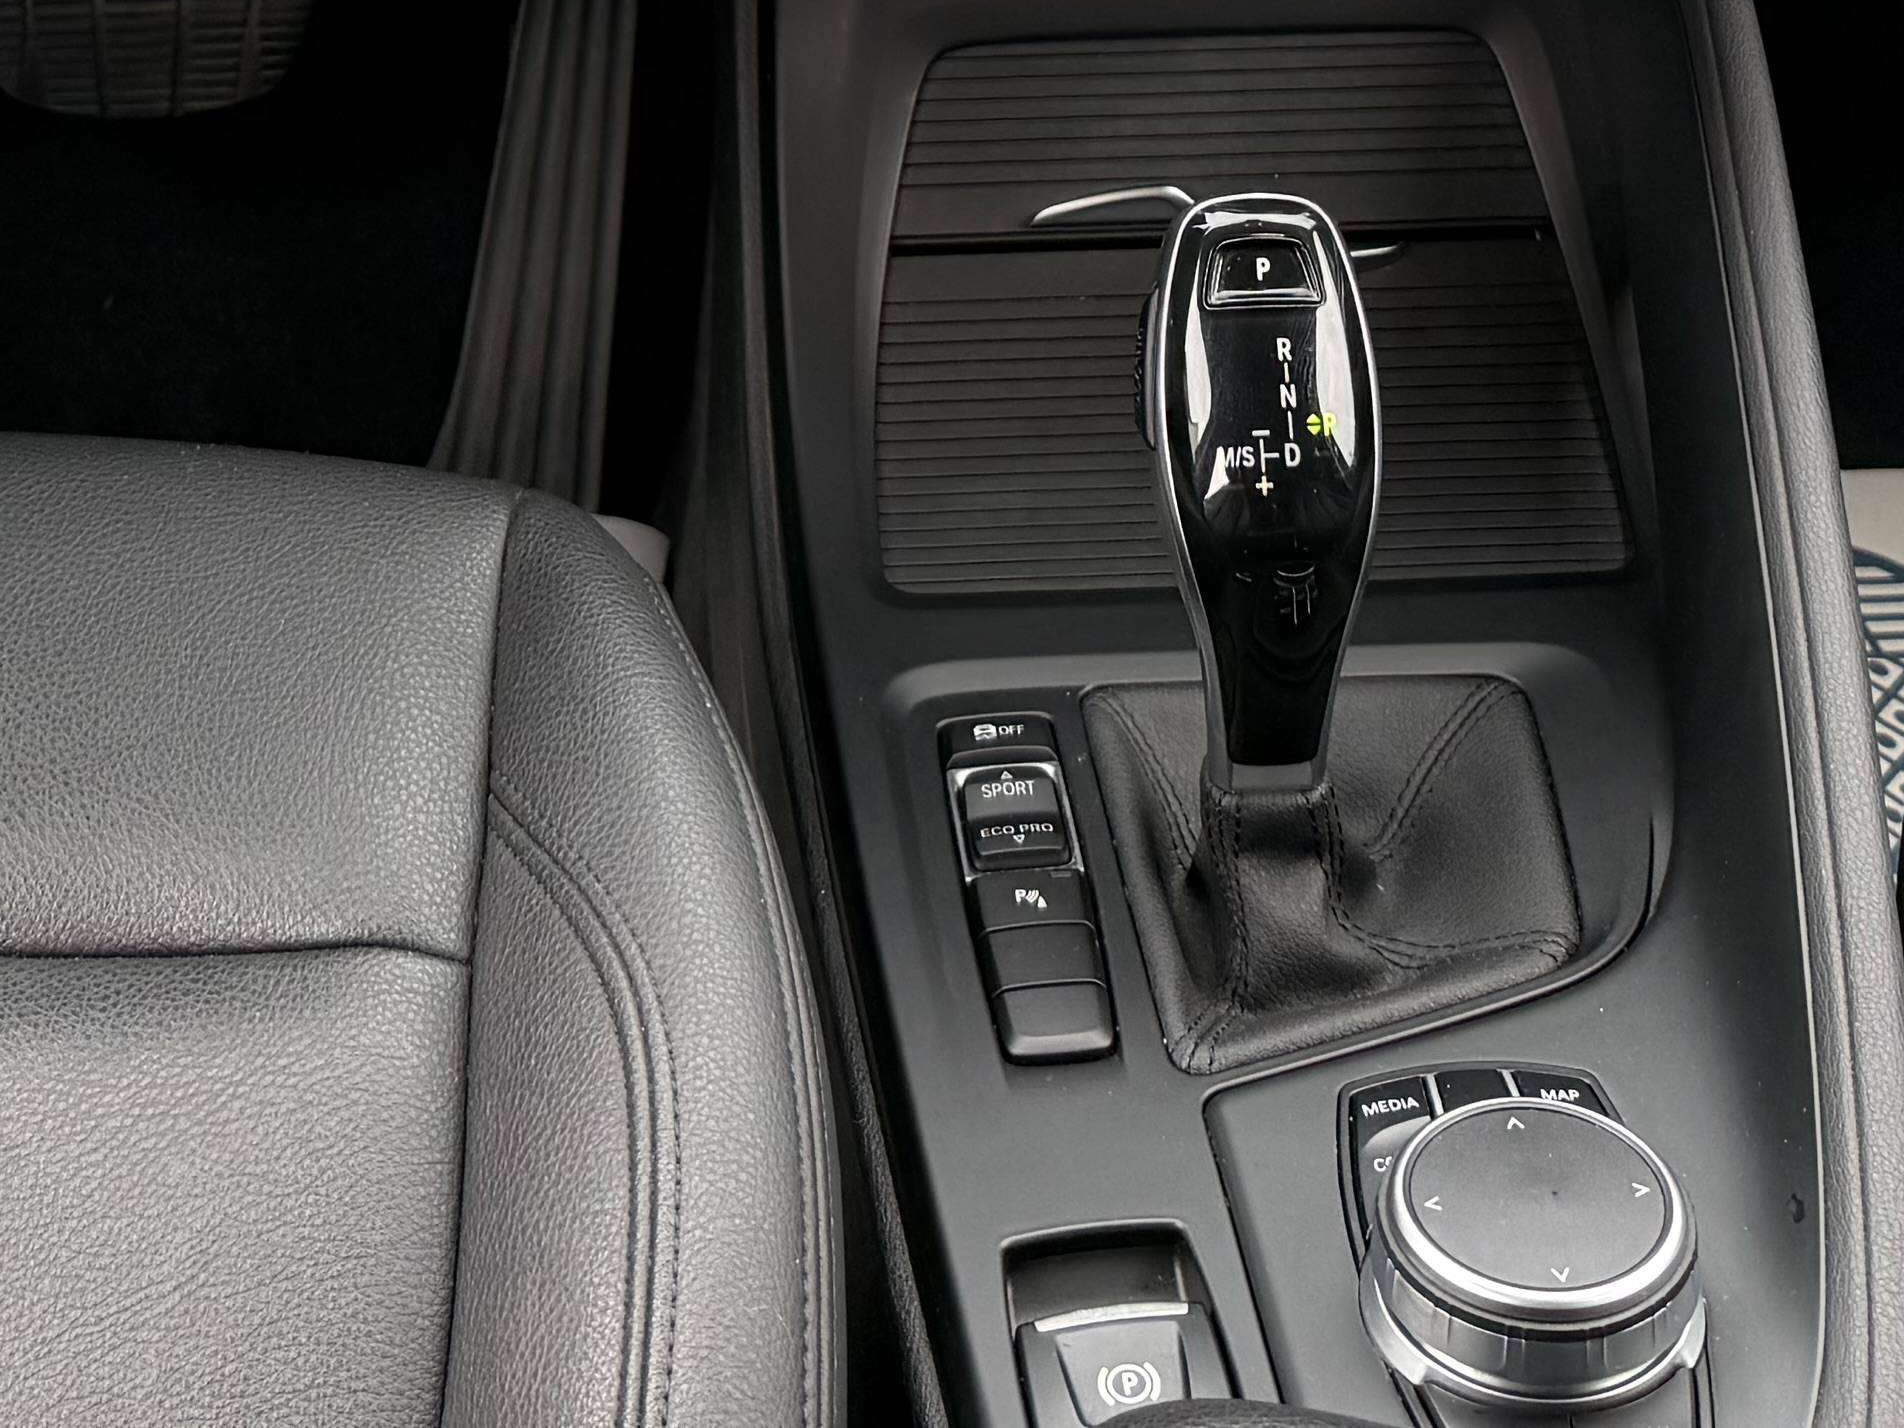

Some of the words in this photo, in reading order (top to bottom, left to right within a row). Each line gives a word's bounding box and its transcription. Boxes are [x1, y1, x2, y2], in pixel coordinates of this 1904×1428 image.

[1255, 257, 1271, 281] P
[1276, 337, 1293, 362] R
[1280, 383, 1297, 409] N
[1216, 446, 1255, 468] M/S
[1284, 443, 1301, 467] D
[998, 724, 1025, 735] OFF
[981, 780, 1035, 798] SPORT
[980, 825, 1015, 838] ECO
[1019, 823, 1054, 833] PRO
[1540, 1088, 1580, 1102] MAP
[1361, 1096, 1420, 1118] MEDIA
[1121, 1371, 1137, 1397] P
